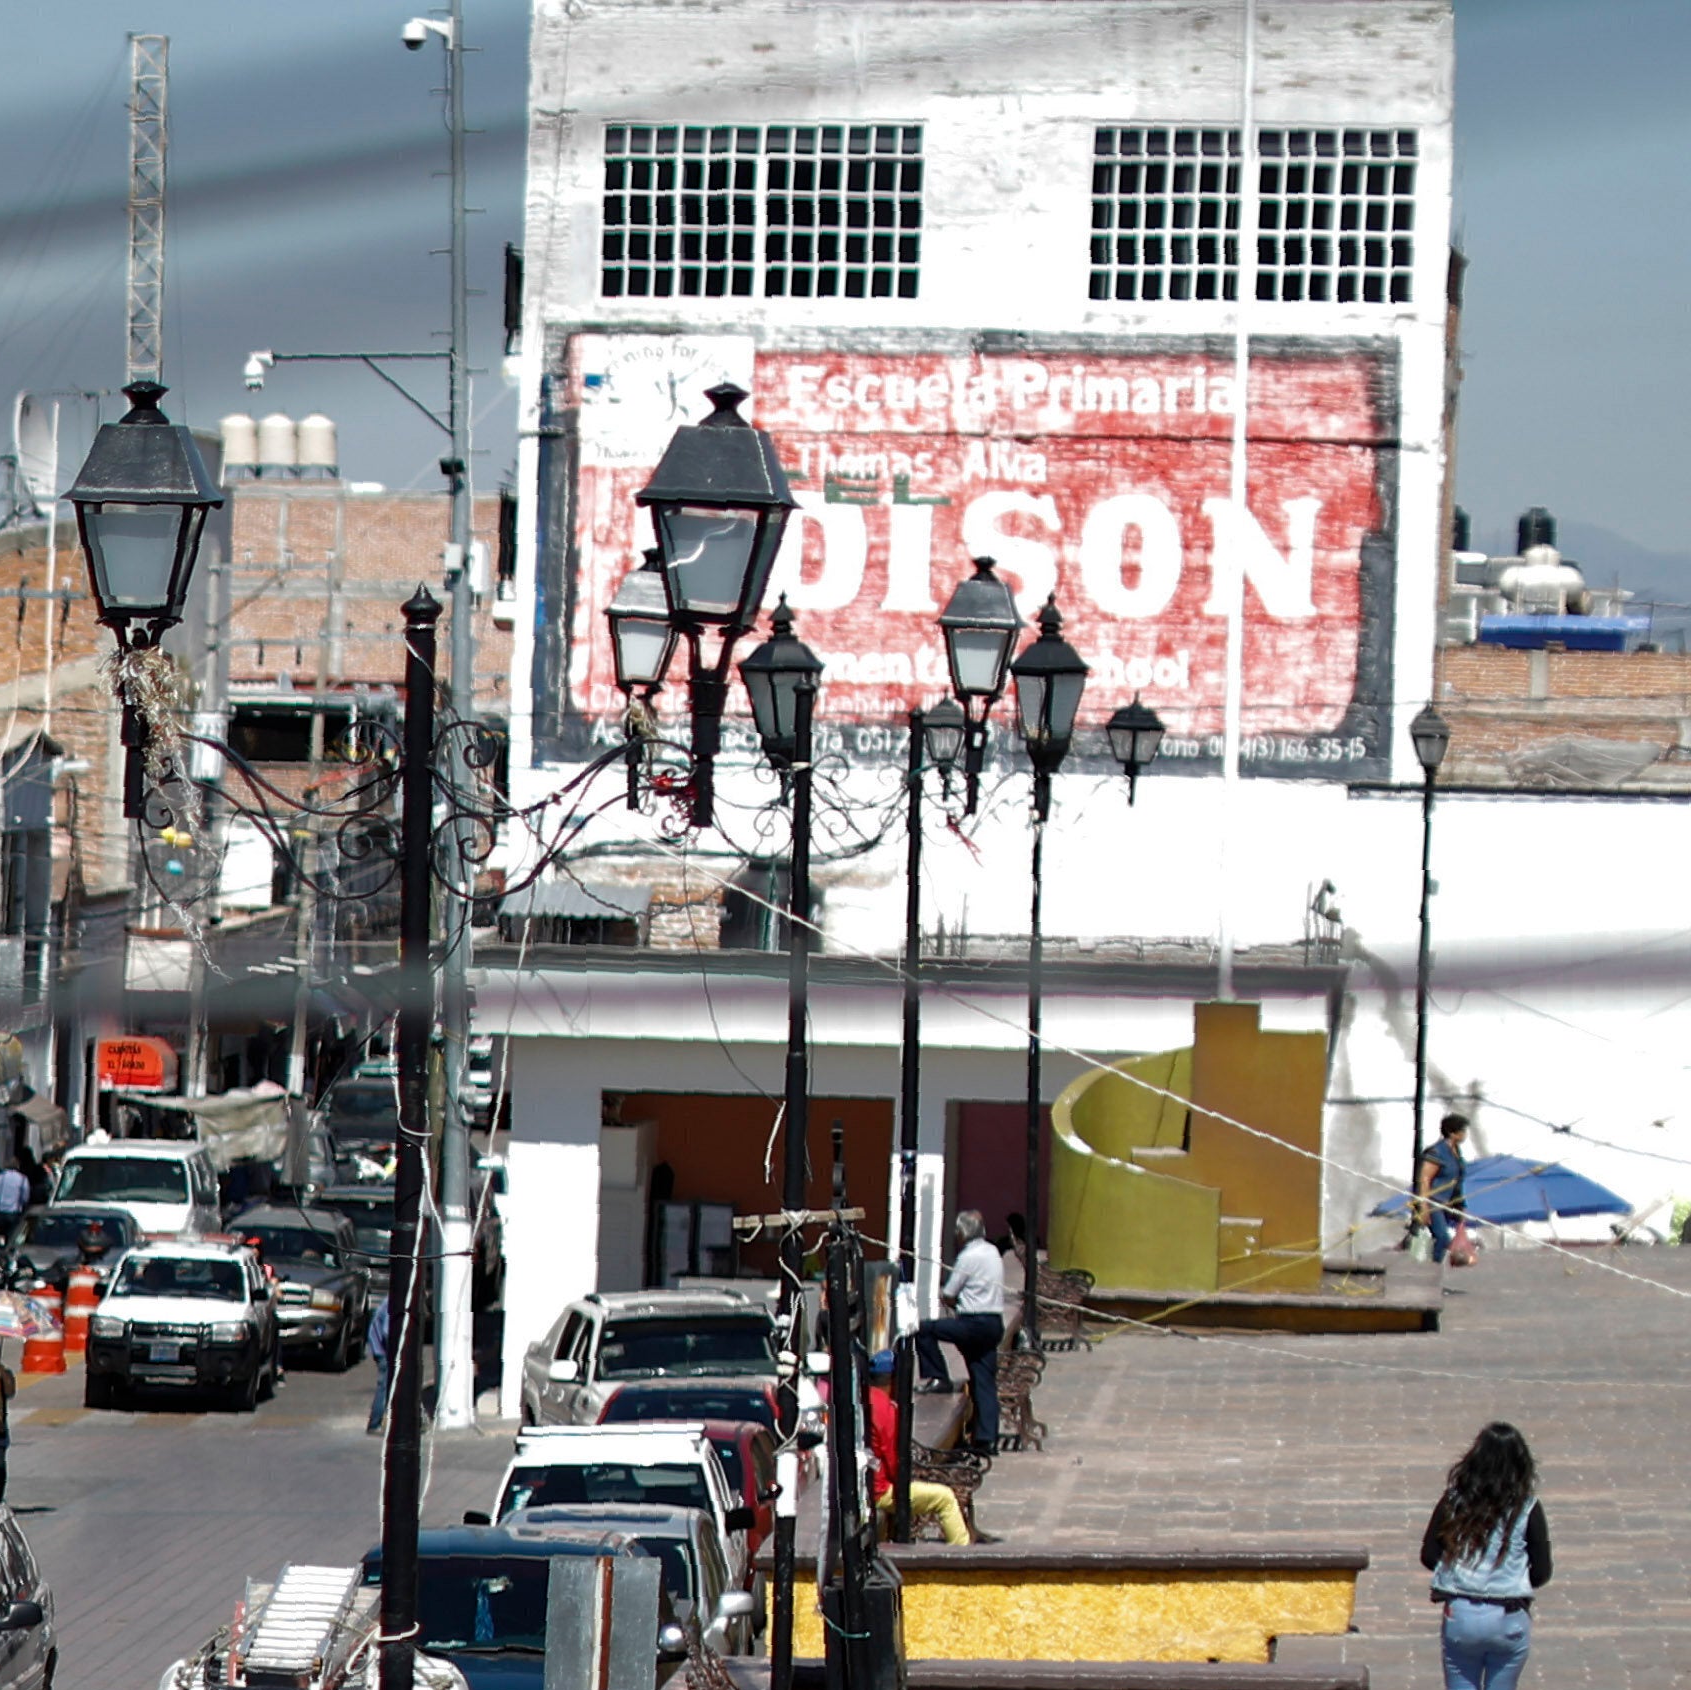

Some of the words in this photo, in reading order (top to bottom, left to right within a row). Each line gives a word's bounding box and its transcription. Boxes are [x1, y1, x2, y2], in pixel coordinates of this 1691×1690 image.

[786, 360, 998, 412] Escuela
[1012, 361, 1237, 414] Primaria
[962, 442, 1047, 482] Alva
[762, 490, 1323, 623] DISON
